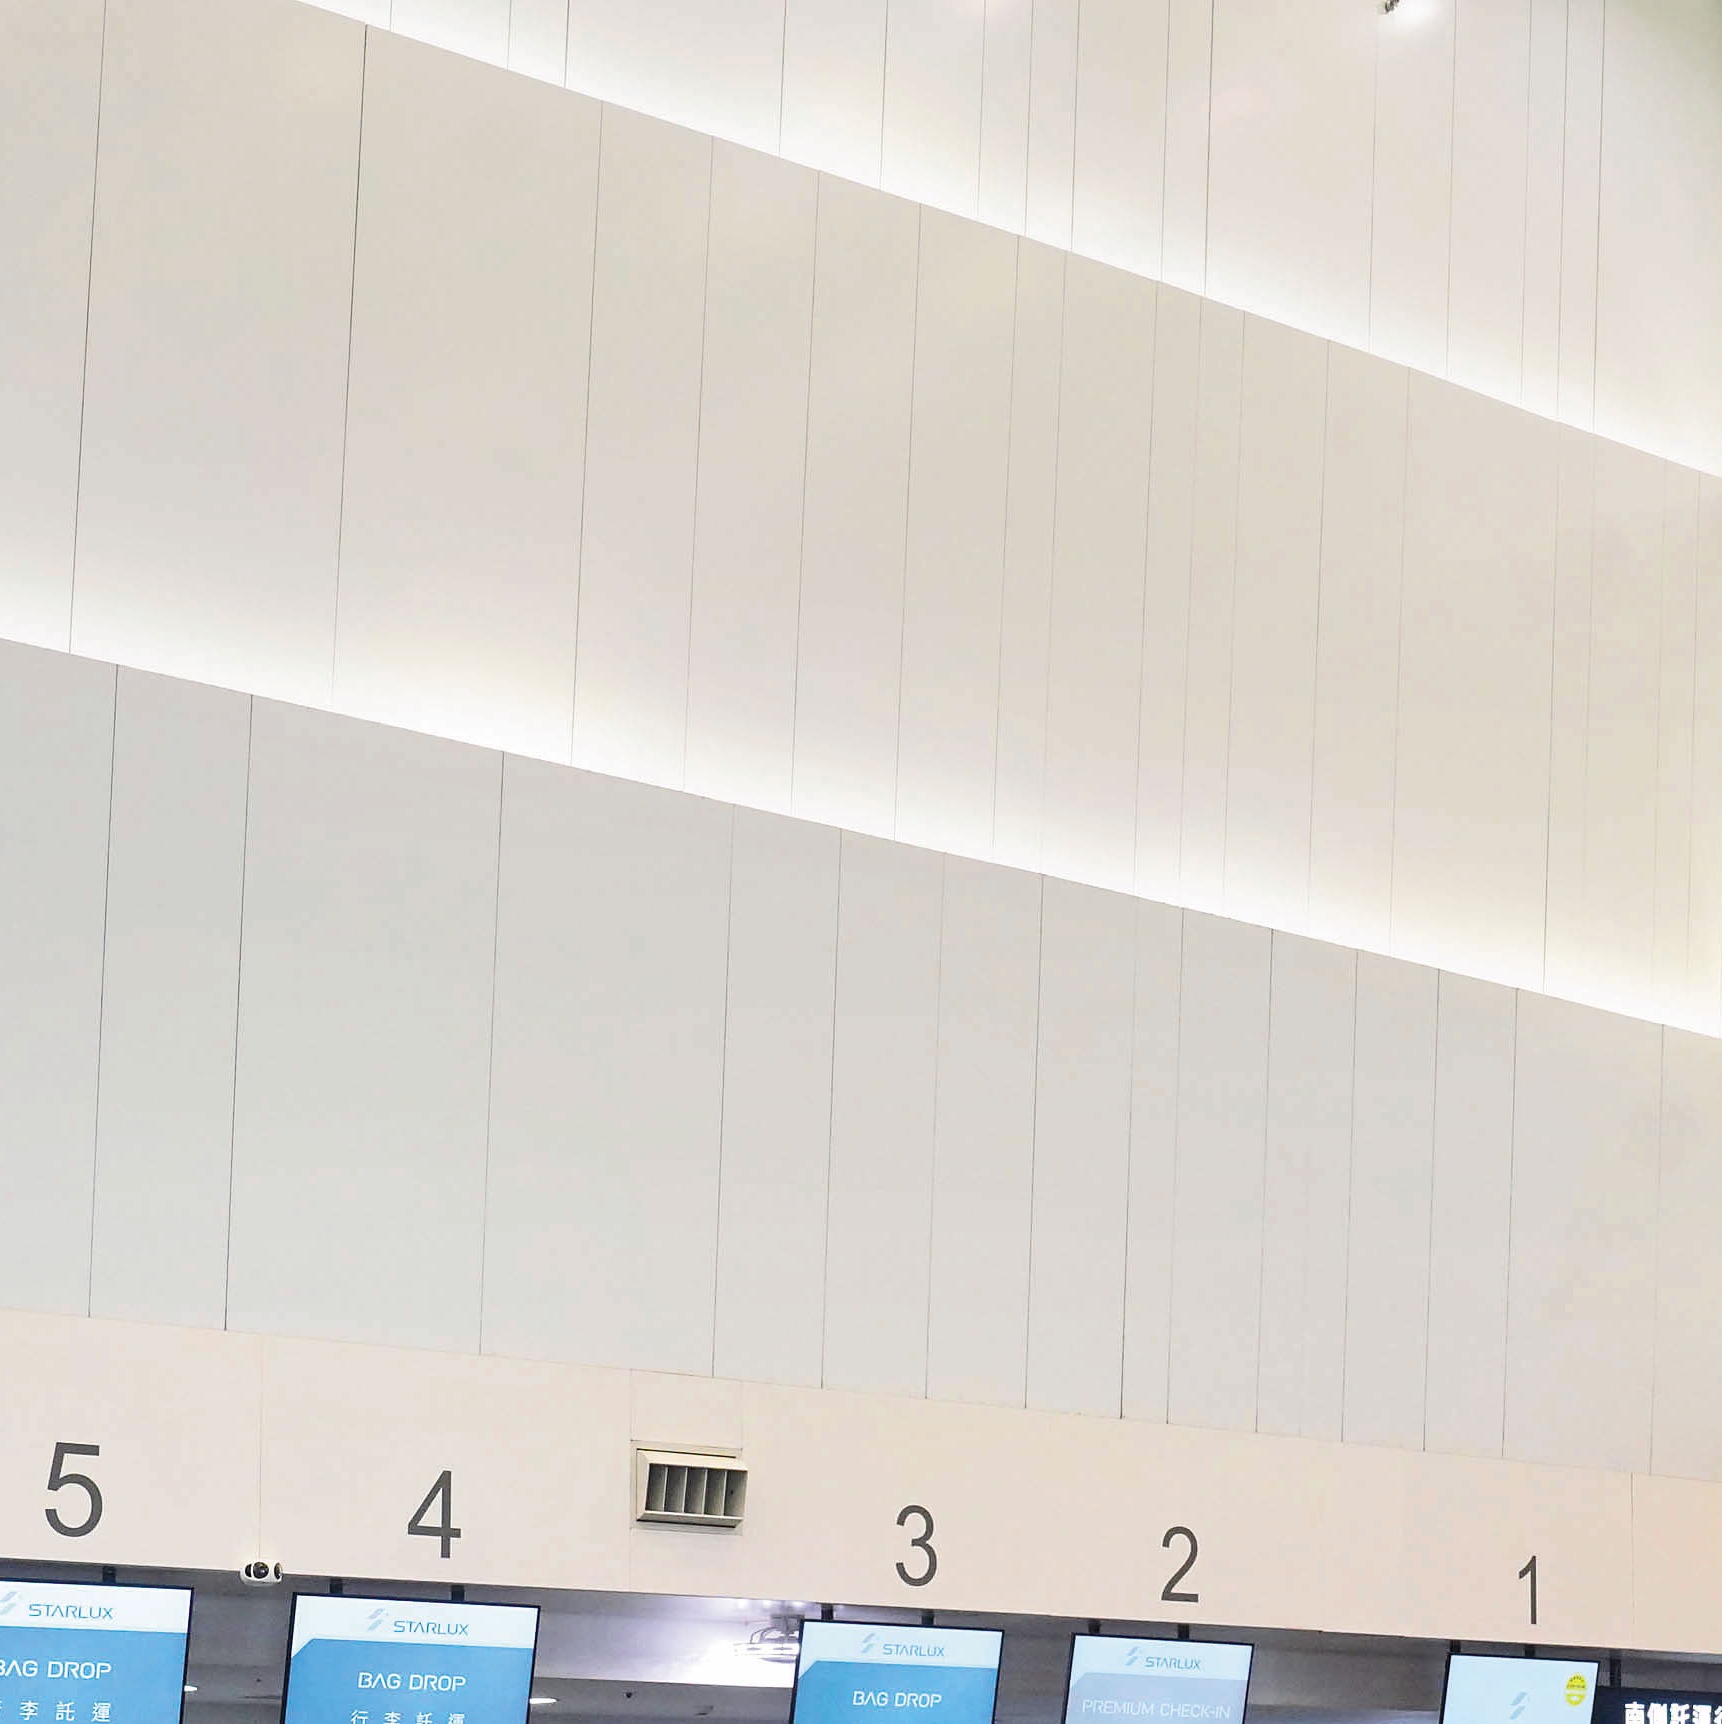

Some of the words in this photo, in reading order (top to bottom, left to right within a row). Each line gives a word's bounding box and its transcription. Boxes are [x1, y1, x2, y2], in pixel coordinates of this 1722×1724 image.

[45, 1442, 104, 1537] 5
[407, 1470, 462, 1558] 4
[896, 1505, 937, 1587] 3
[1161, 1526, 1199, 1603] 2
[1518, 1556, 1537, 1625] 1
[28, 1602, 113, 1620] STARLUX
[393, 1619, 469, 1637] STARLUX
[882, 1643, 945, 1658] STARLUX
[47, 1660, 112, 1679] DROP
[1145, 1656, 1201, 1670] STARLUX
[357, 1672, 401, 1690] BAG
[409, 1673, 466, 1692] DROP
[852, 1691, 889, 1708] BAG
[895, 1692, 942, 1709] DROP
[1082, 1699, 1155, 1715] PREMIUM
[1160, 1704, 1230, 1719] CHECK-IN
